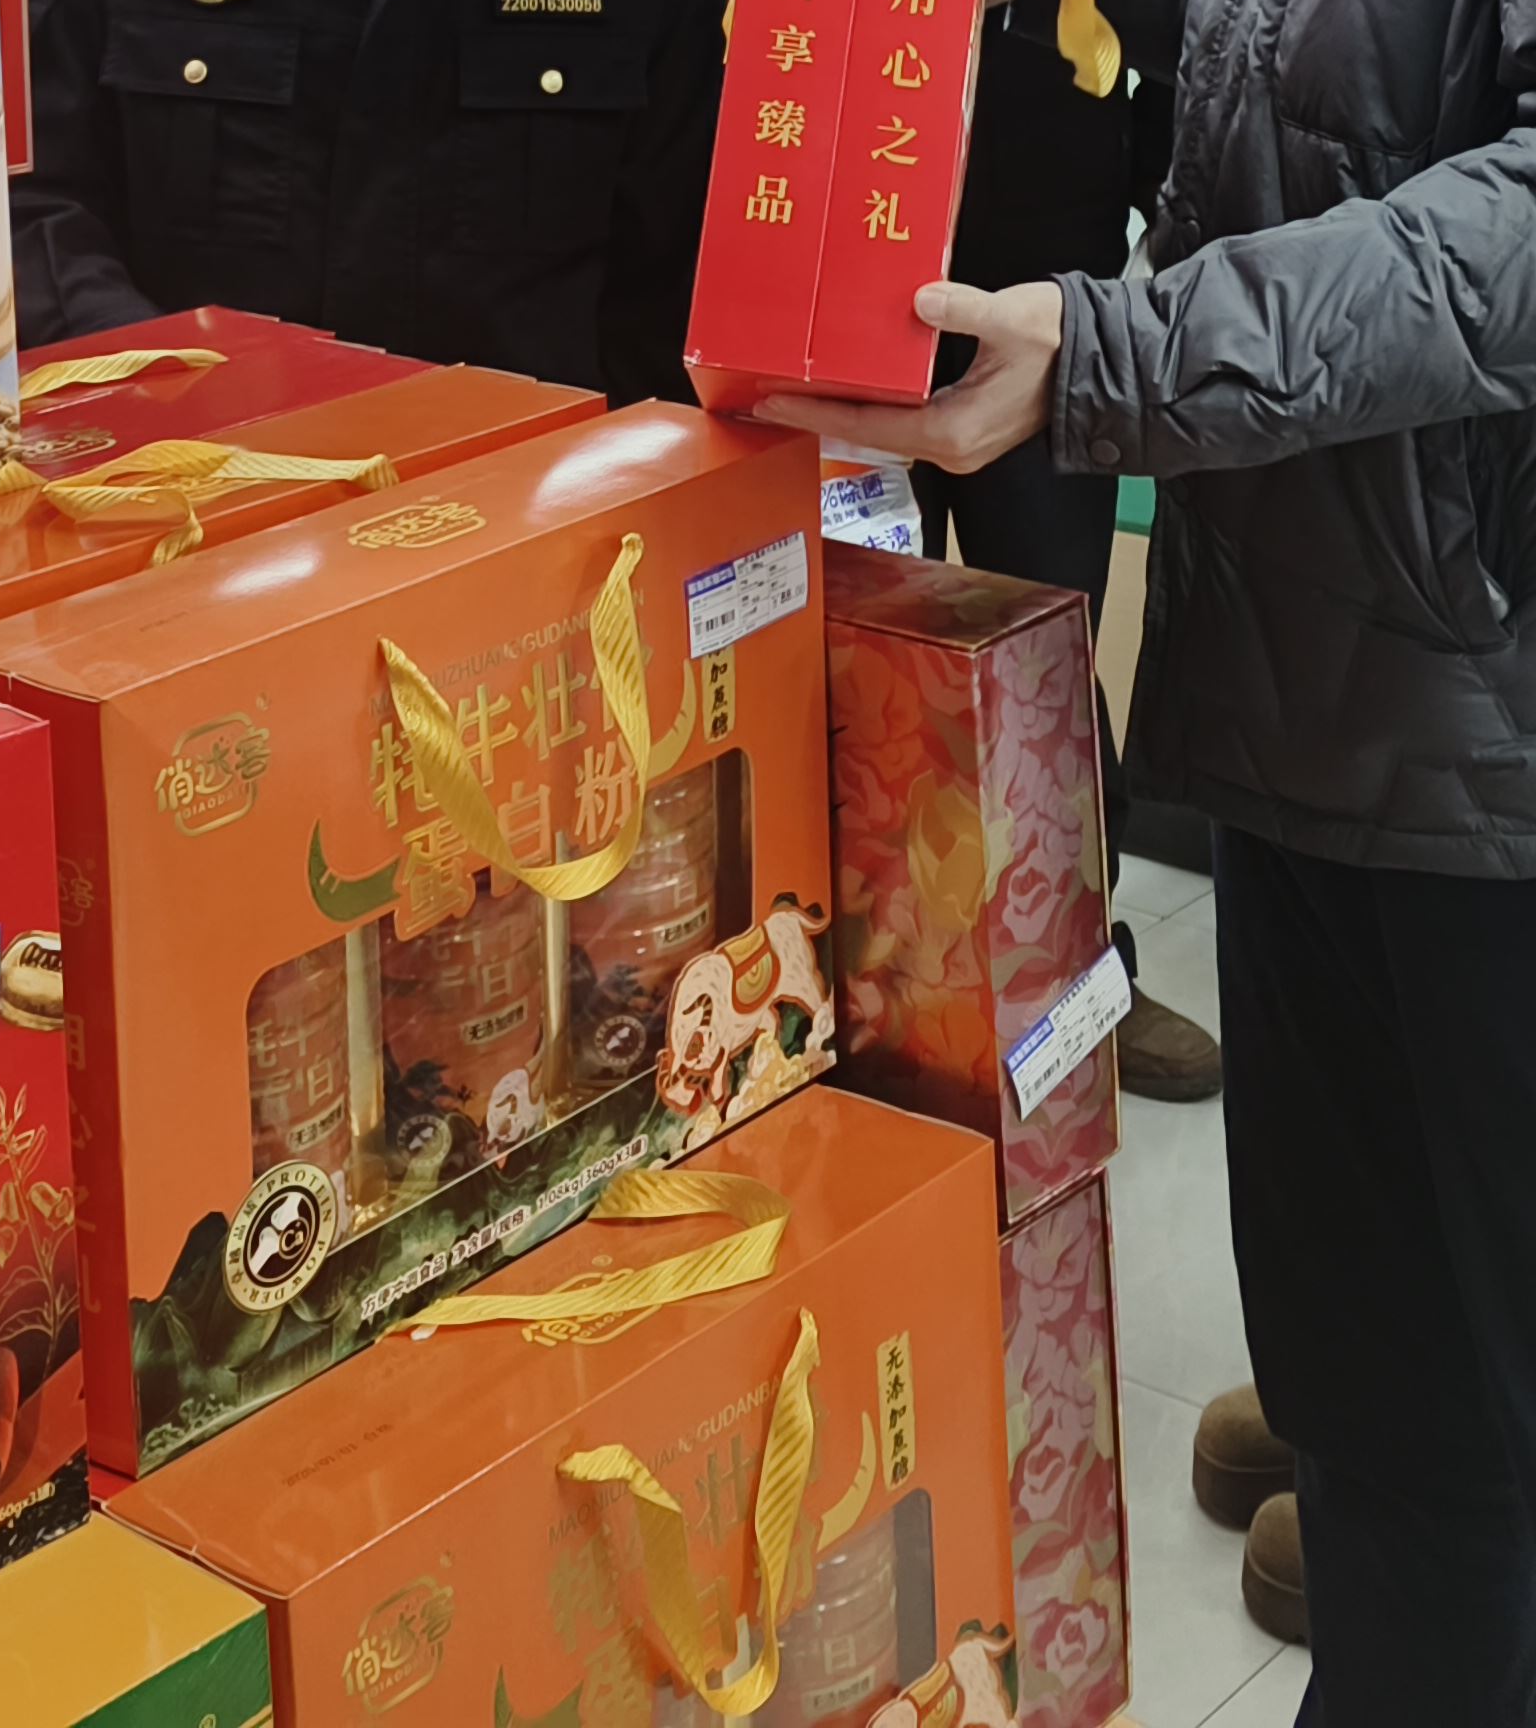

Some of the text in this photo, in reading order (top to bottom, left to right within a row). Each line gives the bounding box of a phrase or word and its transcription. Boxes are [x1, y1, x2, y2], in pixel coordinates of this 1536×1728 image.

[154, 725, 272, 814] 俏达客
[885, 1344, 909, 1486] 无添加蔗糖
